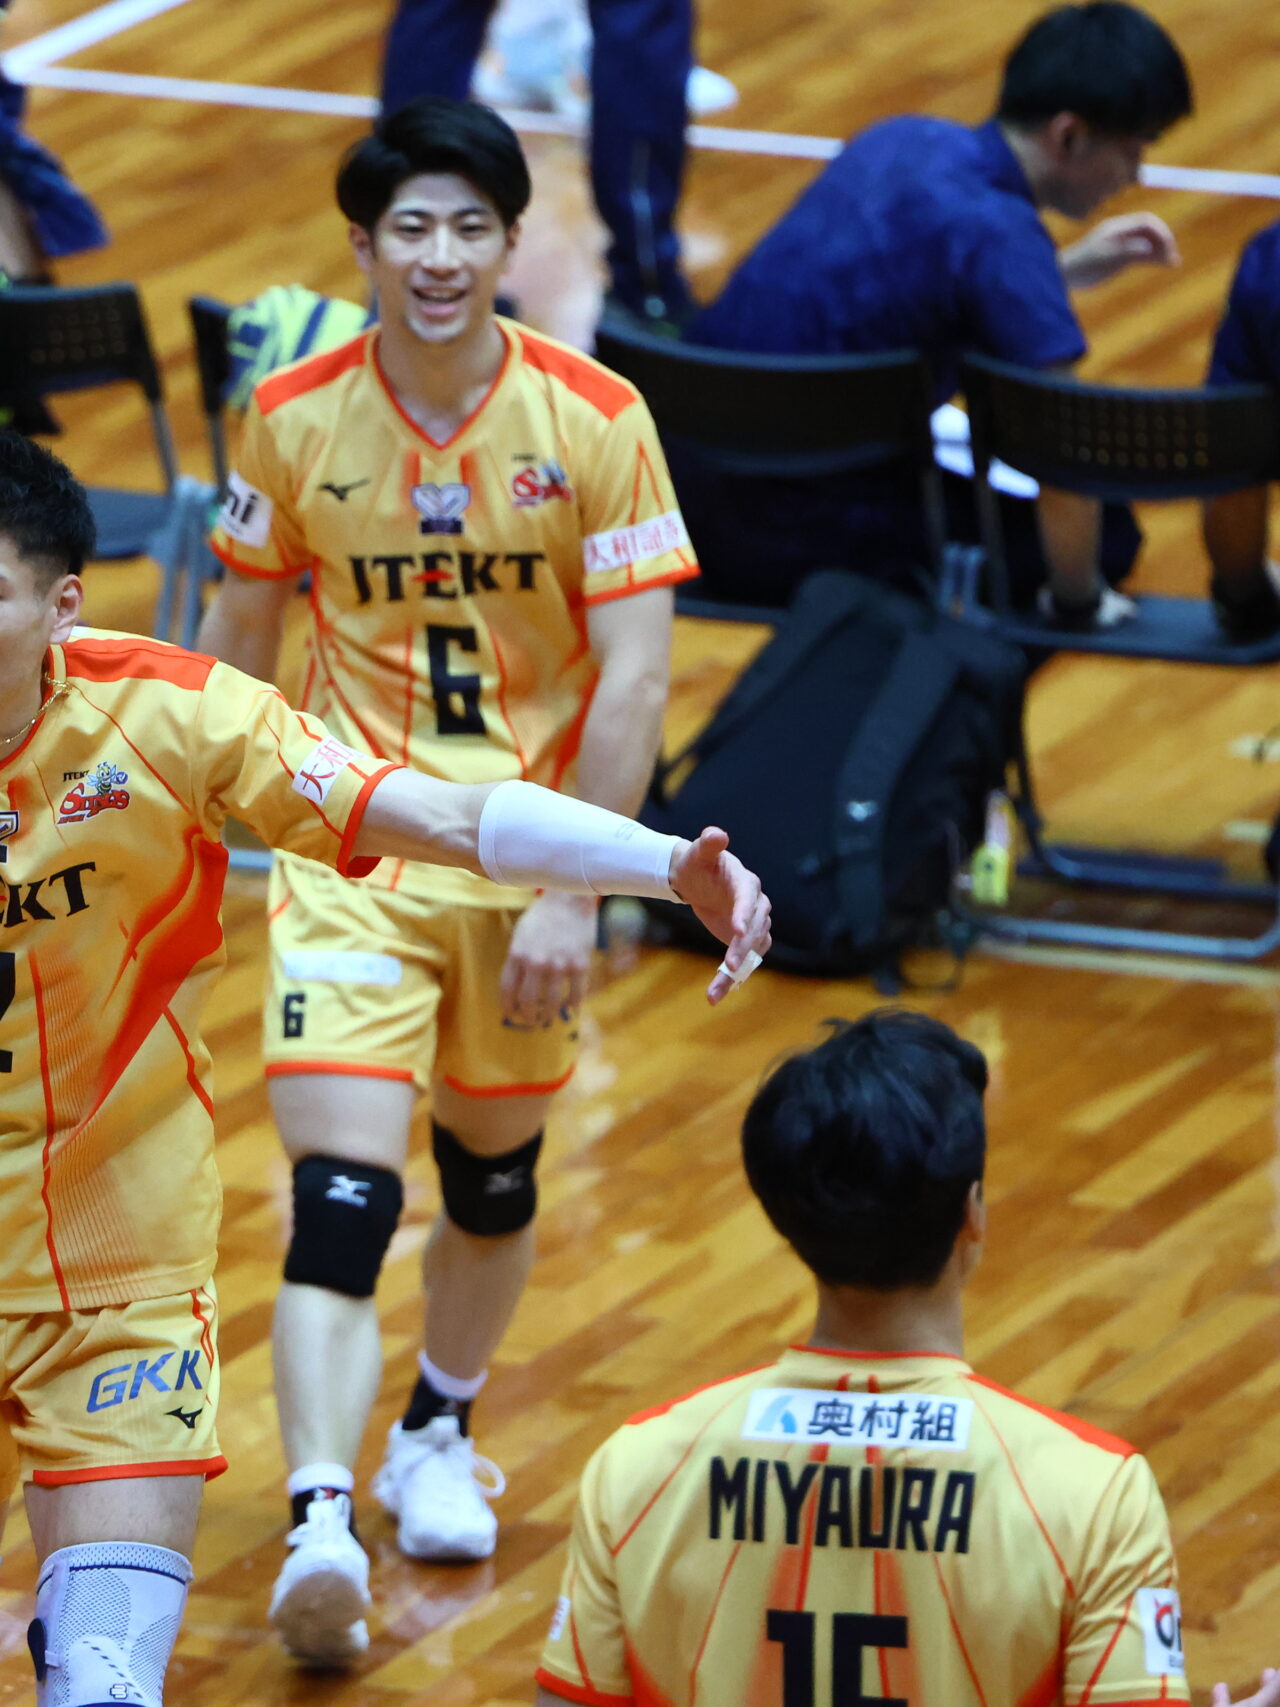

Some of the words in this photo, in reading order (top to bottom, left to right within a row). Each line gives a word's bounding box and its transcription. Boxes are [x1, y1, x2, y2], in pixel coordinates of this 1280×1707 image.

[349, 551, 545, 606] JTEKT
[426, 623, 487, 735] 6
[283, 992, 306, 1038] 6
[86, 1349, 203, 1414] GKK
[807, 1398, 958, 1442] 奥村組
[708, 1456, 977, 1554] MIYAURA
